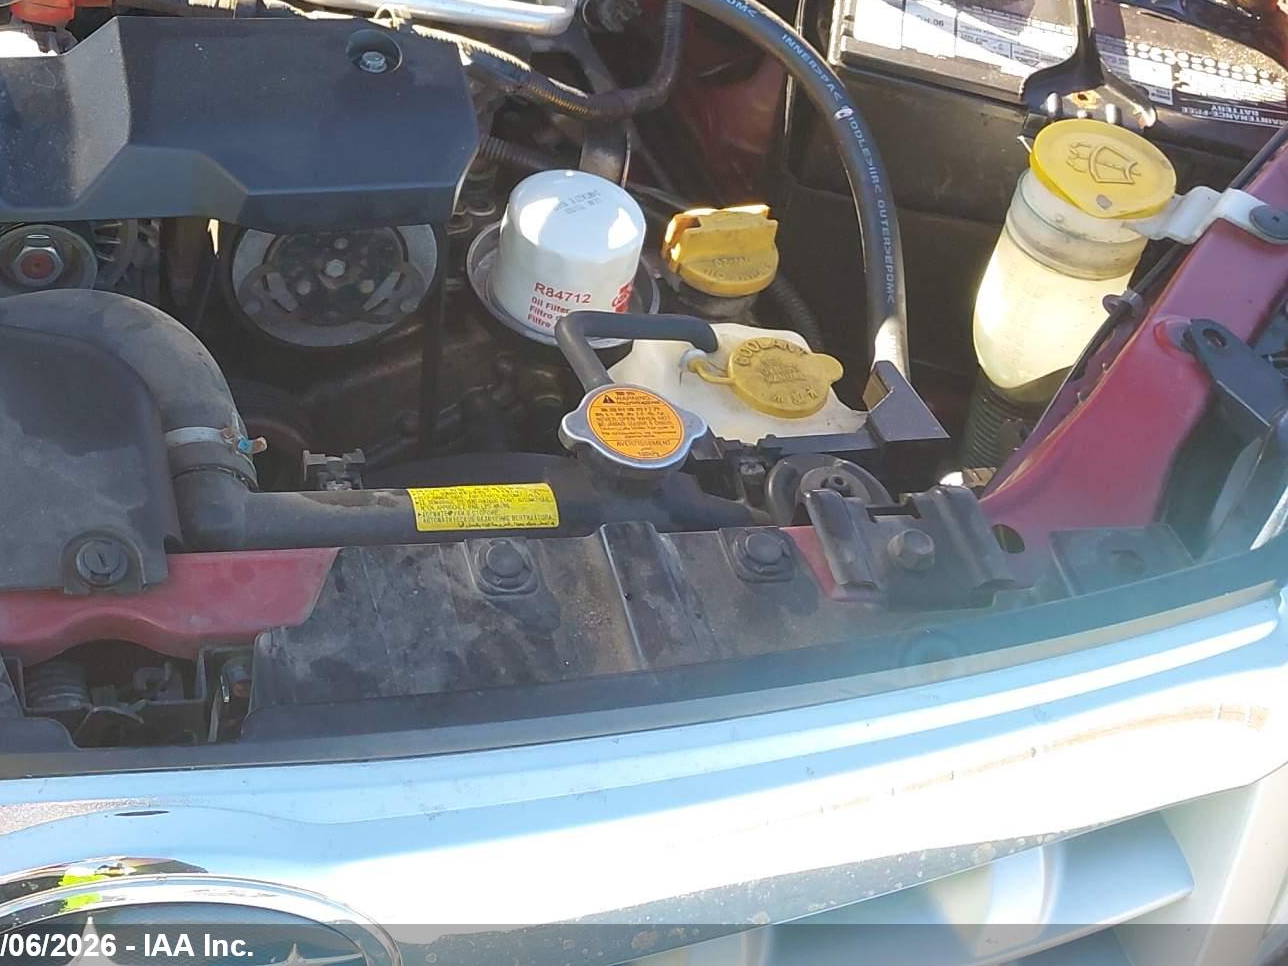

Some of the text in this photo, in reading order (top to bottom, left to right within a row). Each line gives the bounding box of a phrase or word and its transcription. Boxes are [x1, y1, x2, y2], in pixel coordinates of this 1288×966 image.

[1210, 104, 1259, 116] BATTERY
[534, 281, 592, 304] R84712
[529, 304, 553, 320] Filtro
[531, 296, 570, 314] Oil Filter
[734, 339, 809, 366] COOLANT
